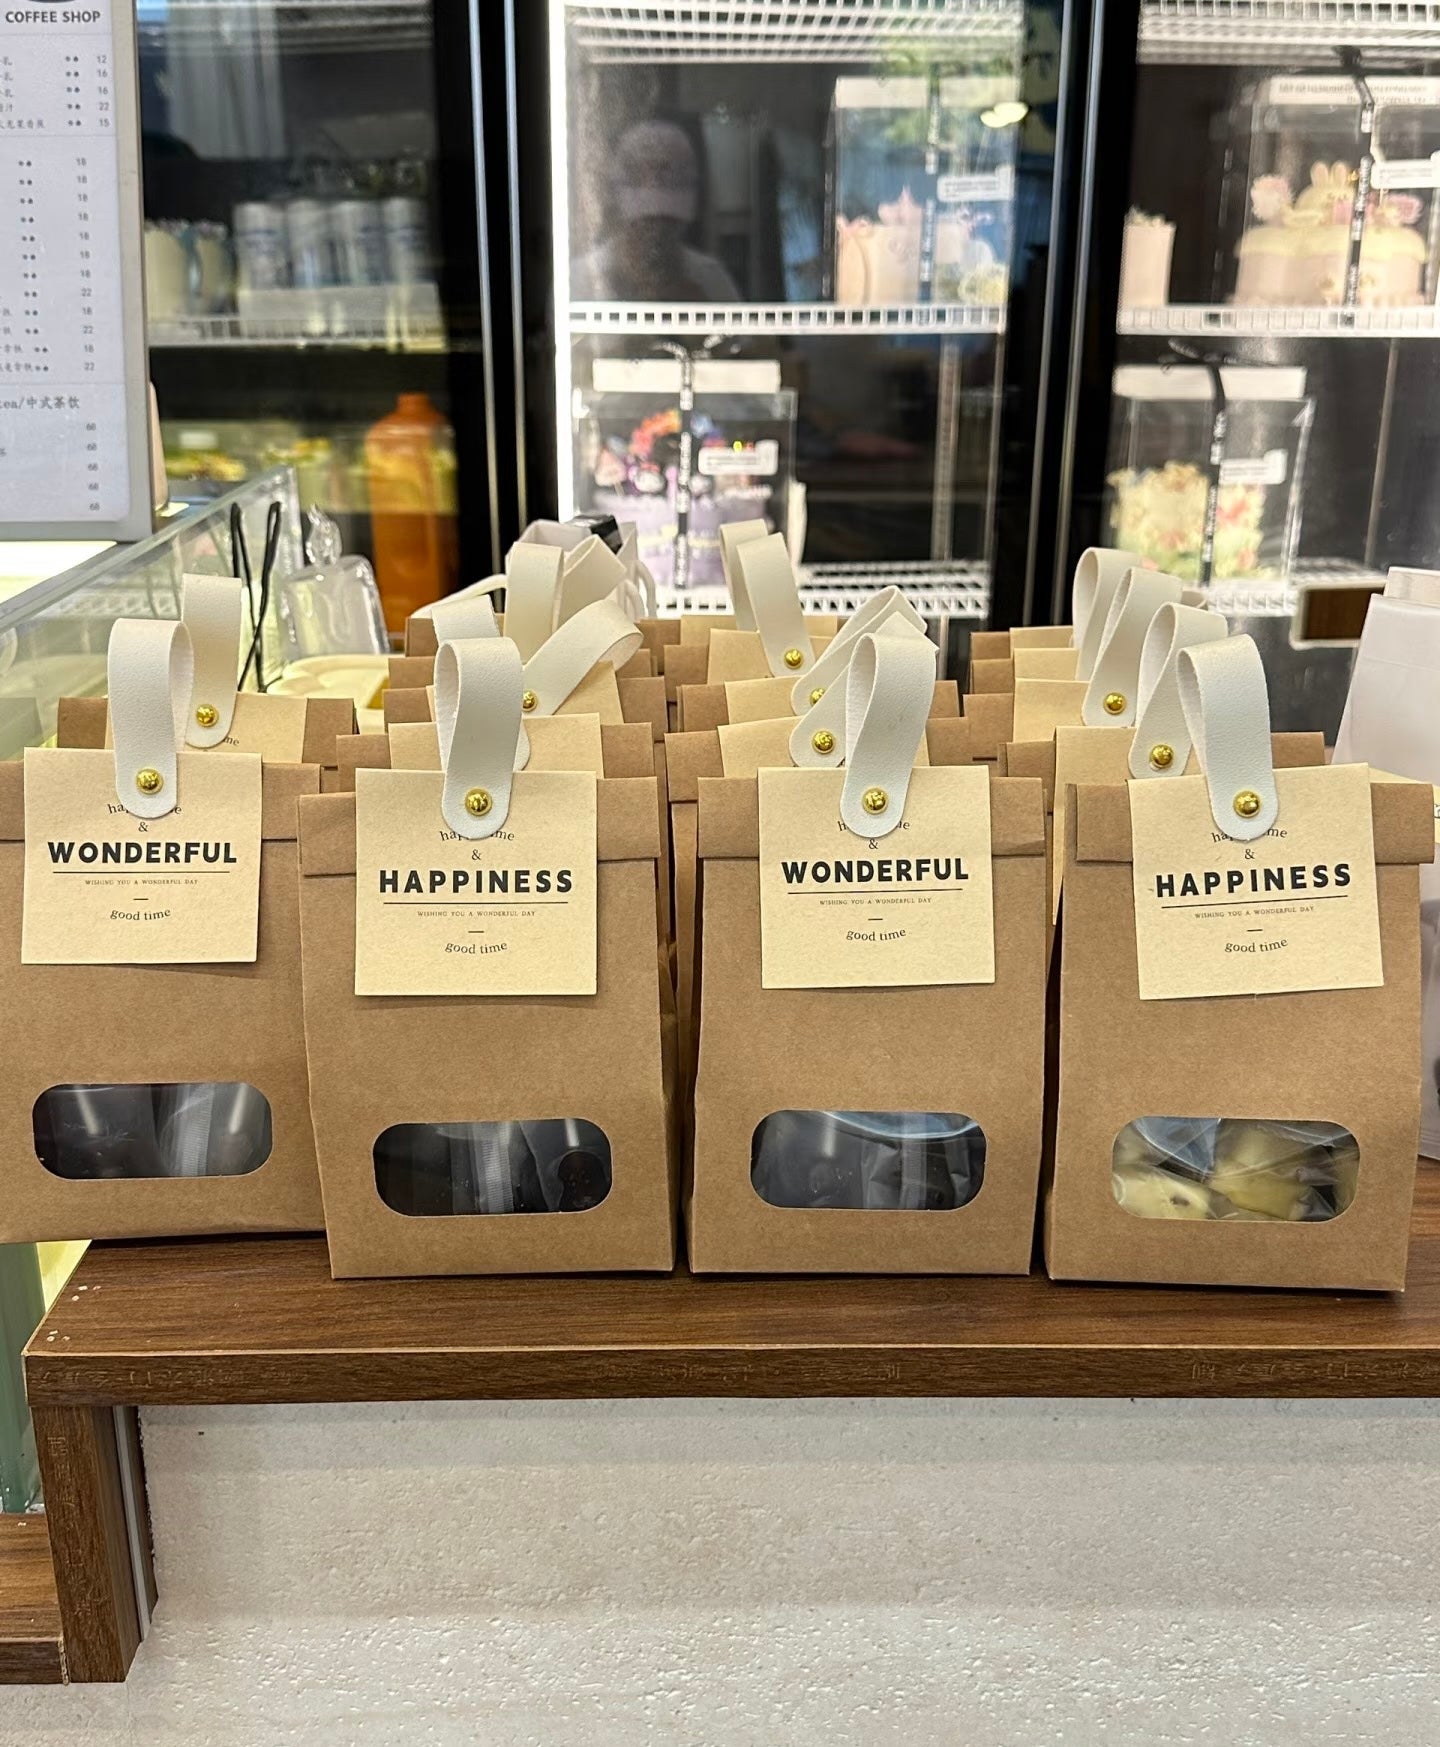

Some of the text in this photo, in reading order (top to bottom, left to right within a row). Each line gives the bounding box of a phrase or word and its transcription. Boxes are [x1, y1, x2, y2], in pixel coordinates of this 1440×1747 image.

[5, 10, 101, 23] COFFEE SHOP
[97, 55, 107, 64] 12
[97, 69, 108, 78] 16
[98, 86, 109, 95] 16
[98, 102, 110, 111] 22
[98, 118, 110, 128] 15
[81, 288, 92, 297] 22
[83, 325, 93, 334] 22
[84, 362, 95, 371] 22
[138, 821, 149, 832] &
[868, 838, 879, 850] &
[47, 841, 237, 864] WONDERFUL
[471, 849, 482, 860] &
[1244, 848, 1256, 860] &
[781, 857, 969, 884] WONDERFUL
[116, 878, 131, 886] YOU
[379, 869, 572, 894] HAPPINESS
[1155, 863, 1351, 898] HAPPINESS
[875, 897, 915, 905] WONDERFUL
[110, 908, 171, 921] good time
[1194, 911, 1225, 919] WISHING
[1253, 907, 1297, 915] WONDERFUL
[1298, 905, 1315, 913] DAY
[846, 928, 906, 941] good time
[445, 941, 508, 954] good time
[1224, 938, 1288, 953] good time
